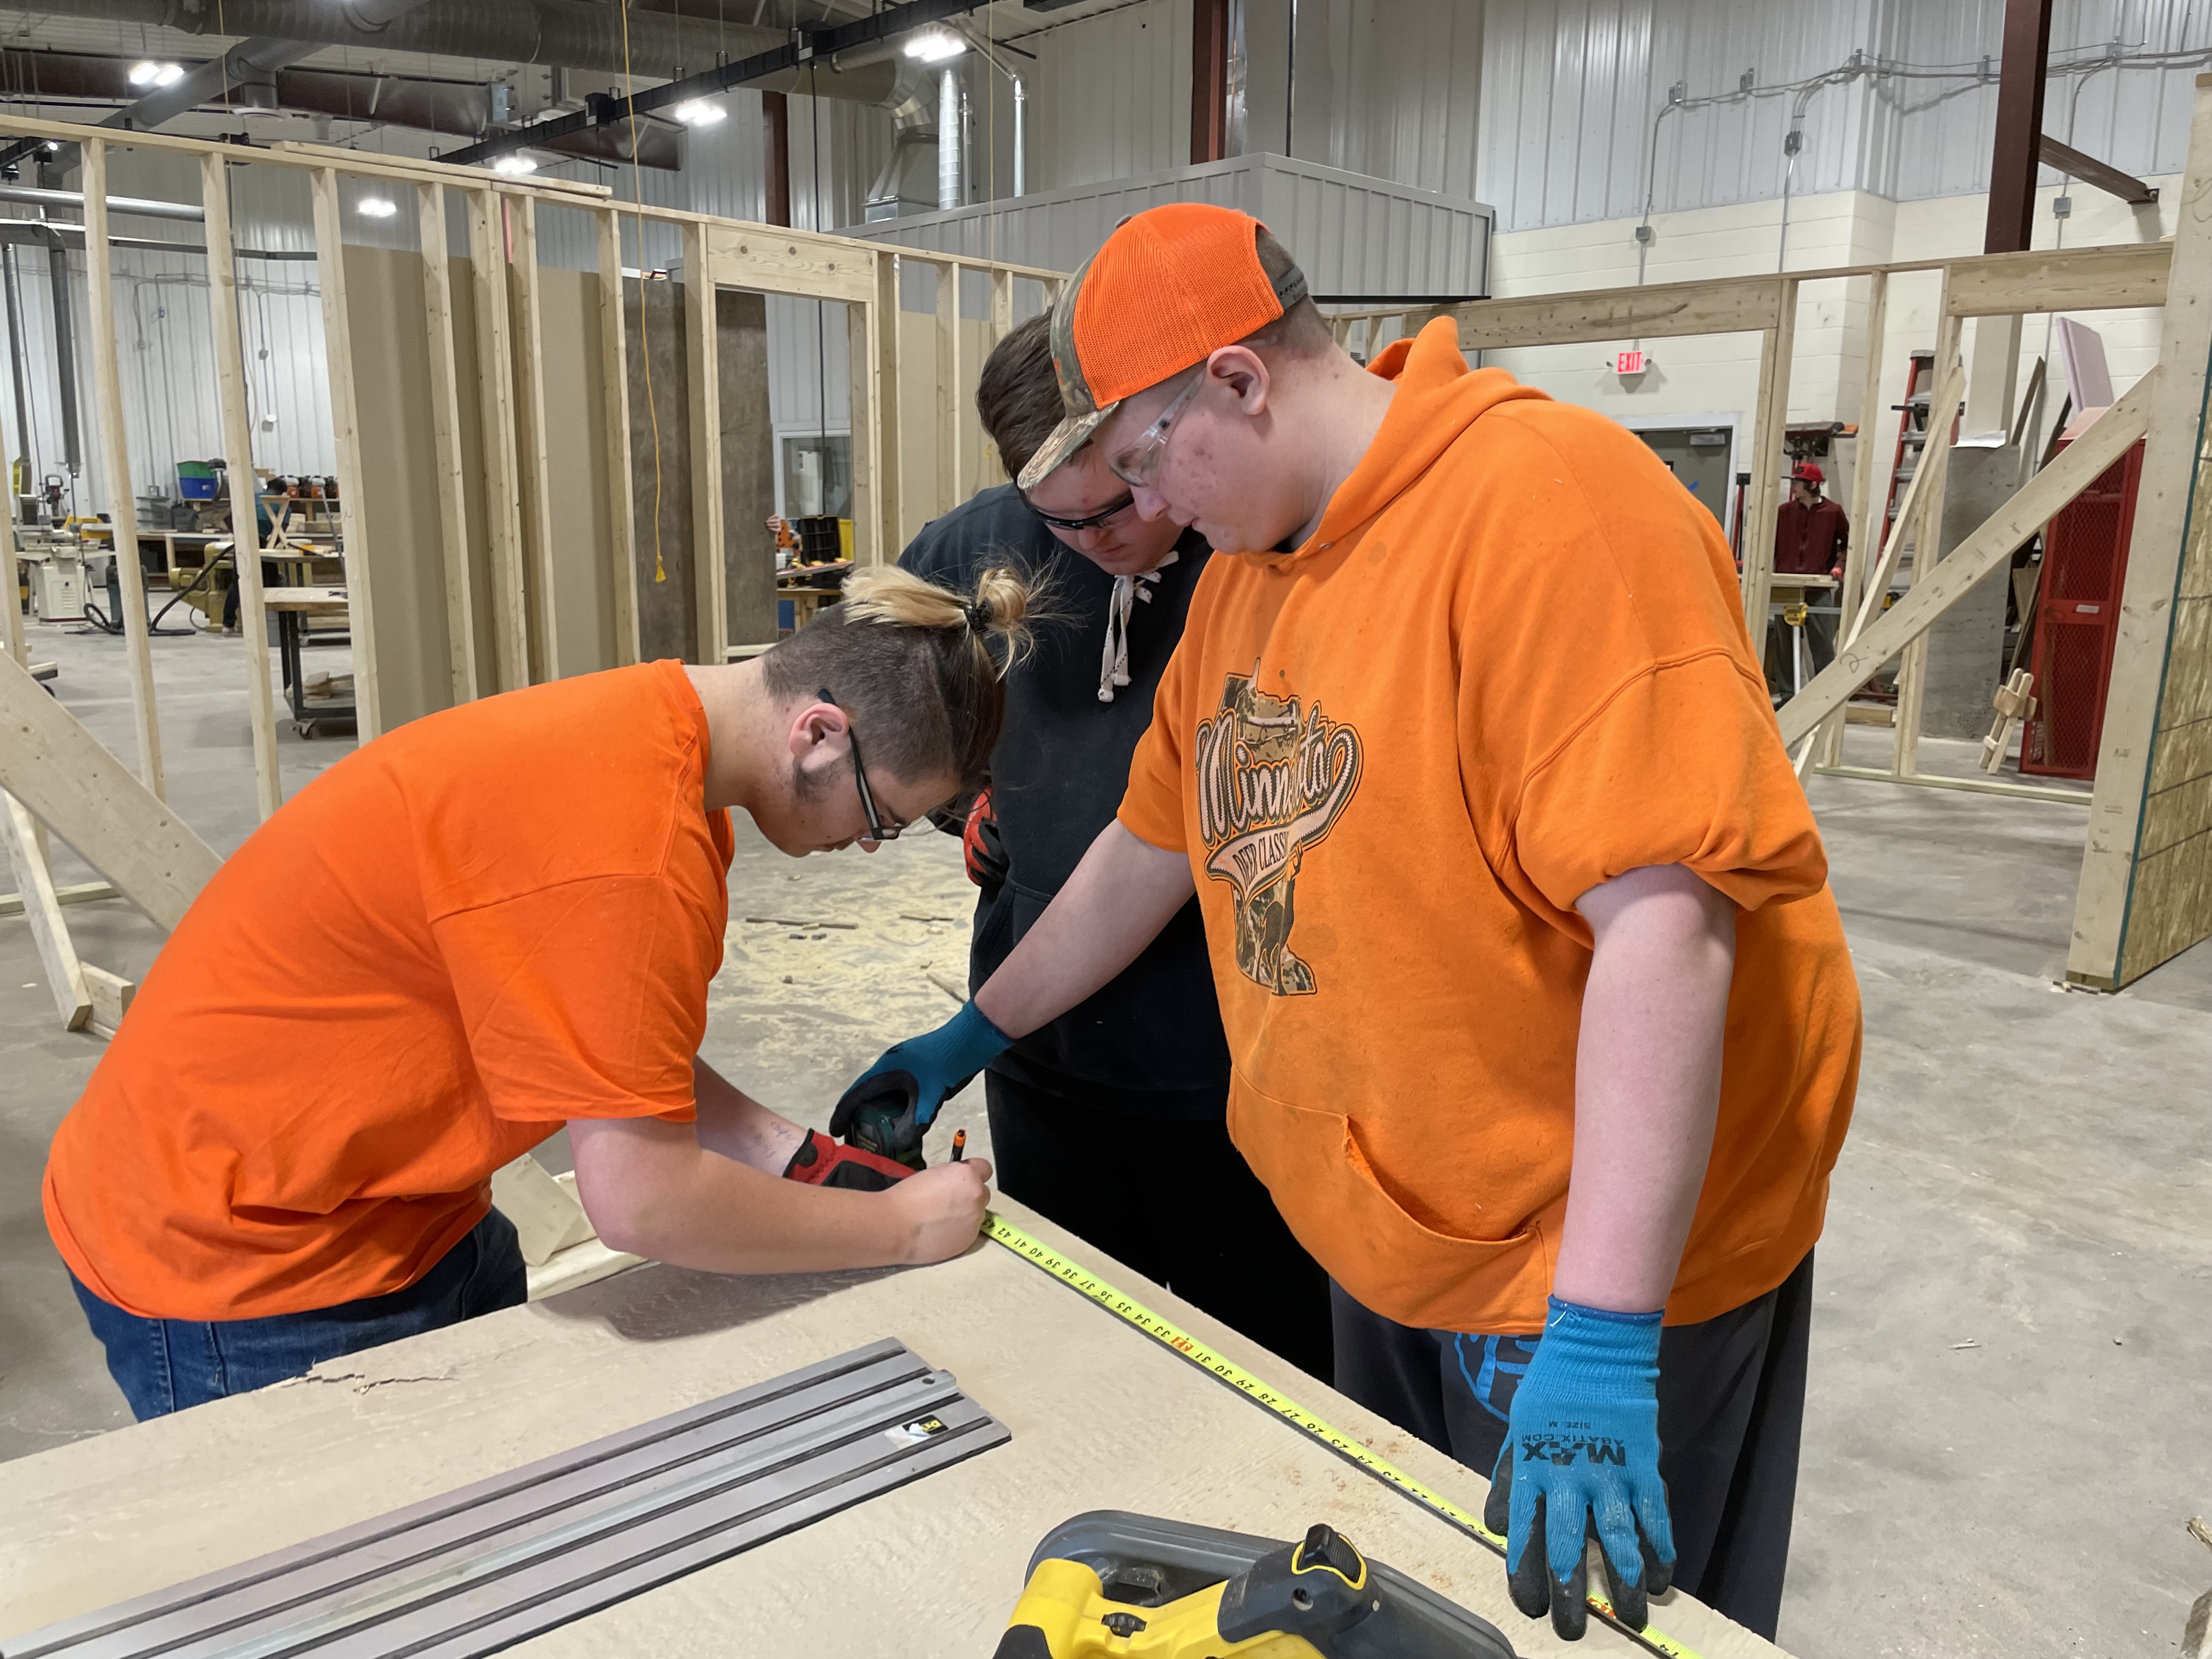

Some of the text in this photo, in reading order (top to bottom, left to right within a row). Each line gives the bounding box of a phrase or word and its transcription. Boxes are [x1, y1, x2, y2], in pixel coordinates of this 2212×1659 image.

[1618, 352, 1641, 373] EXIT
[997, 1228, 1011, 1238] 42
[1014, 1238, 1027, 1247] 41
[1029, 1248, 1043, 1257] 40
[1046, 1259, 1060, 1268] 39
[1063, 1268, 1077, 1279] 38
[1080, 1280, 1095, 1290] 37
[1116, 1302, 1131, 1312] 35
[1135, 1314, 1150, 1325] 34
[1154, 1327, 1170, 1337] 33
[1195, 1353, 1211, 1363] 31
[1215, 1365, 1232, 1376] 30
[1236, 1380, 1255, 1390] 29
[1259, 1393, 1277, 1404] 28
[1282, 1409, 1301, 1420] 27
[1522, 1441, 1626, 1466] MAX
